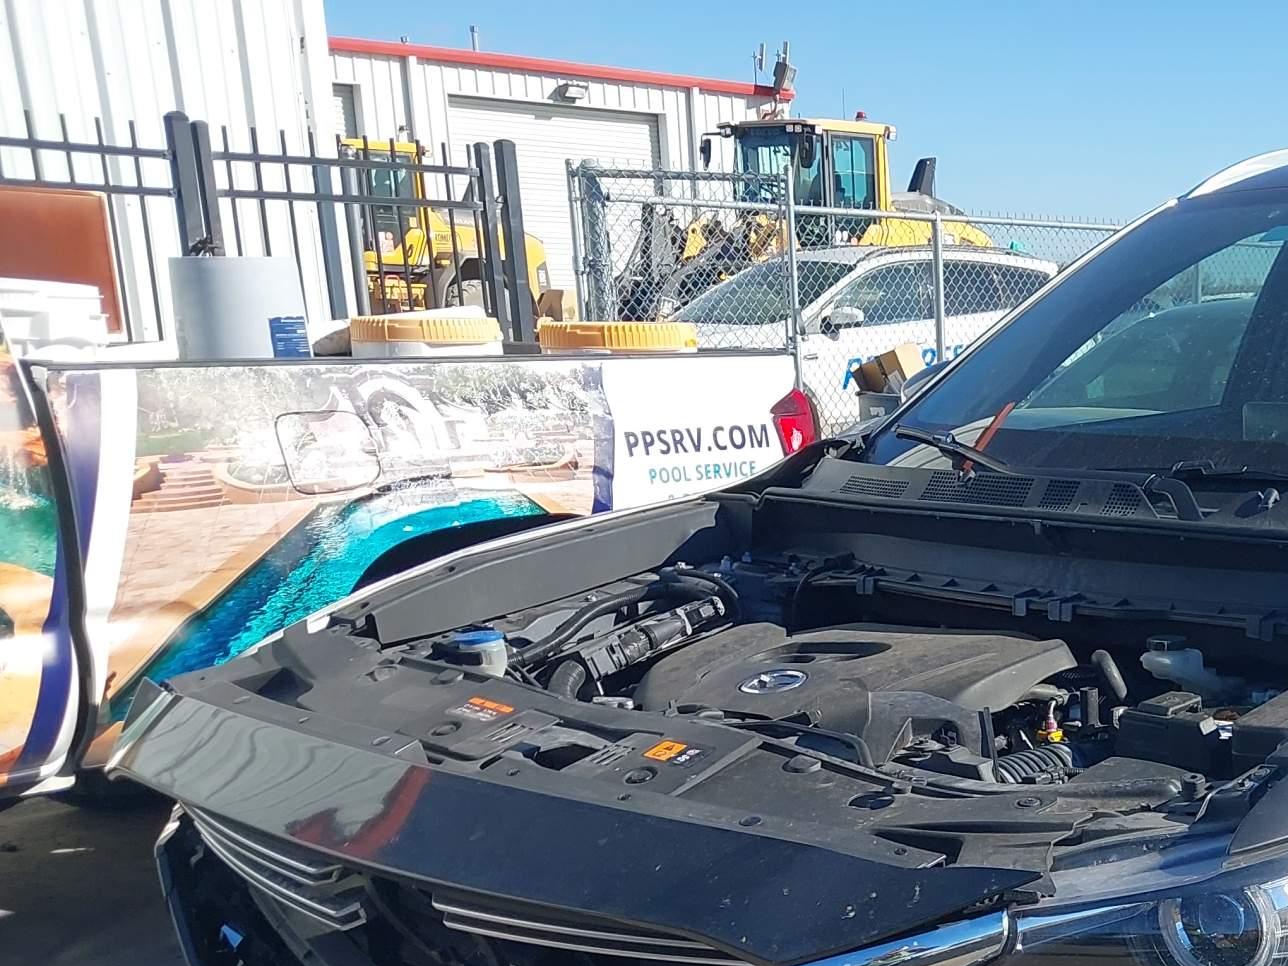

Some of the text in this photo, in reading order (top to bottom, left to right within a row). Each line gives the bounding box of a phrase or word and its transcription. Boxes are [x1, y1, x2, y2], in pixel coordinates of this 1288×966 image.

[624, 423, 770, 457] PPSRV.COM
[649, 460, 757, 484] POOL SERVICE
